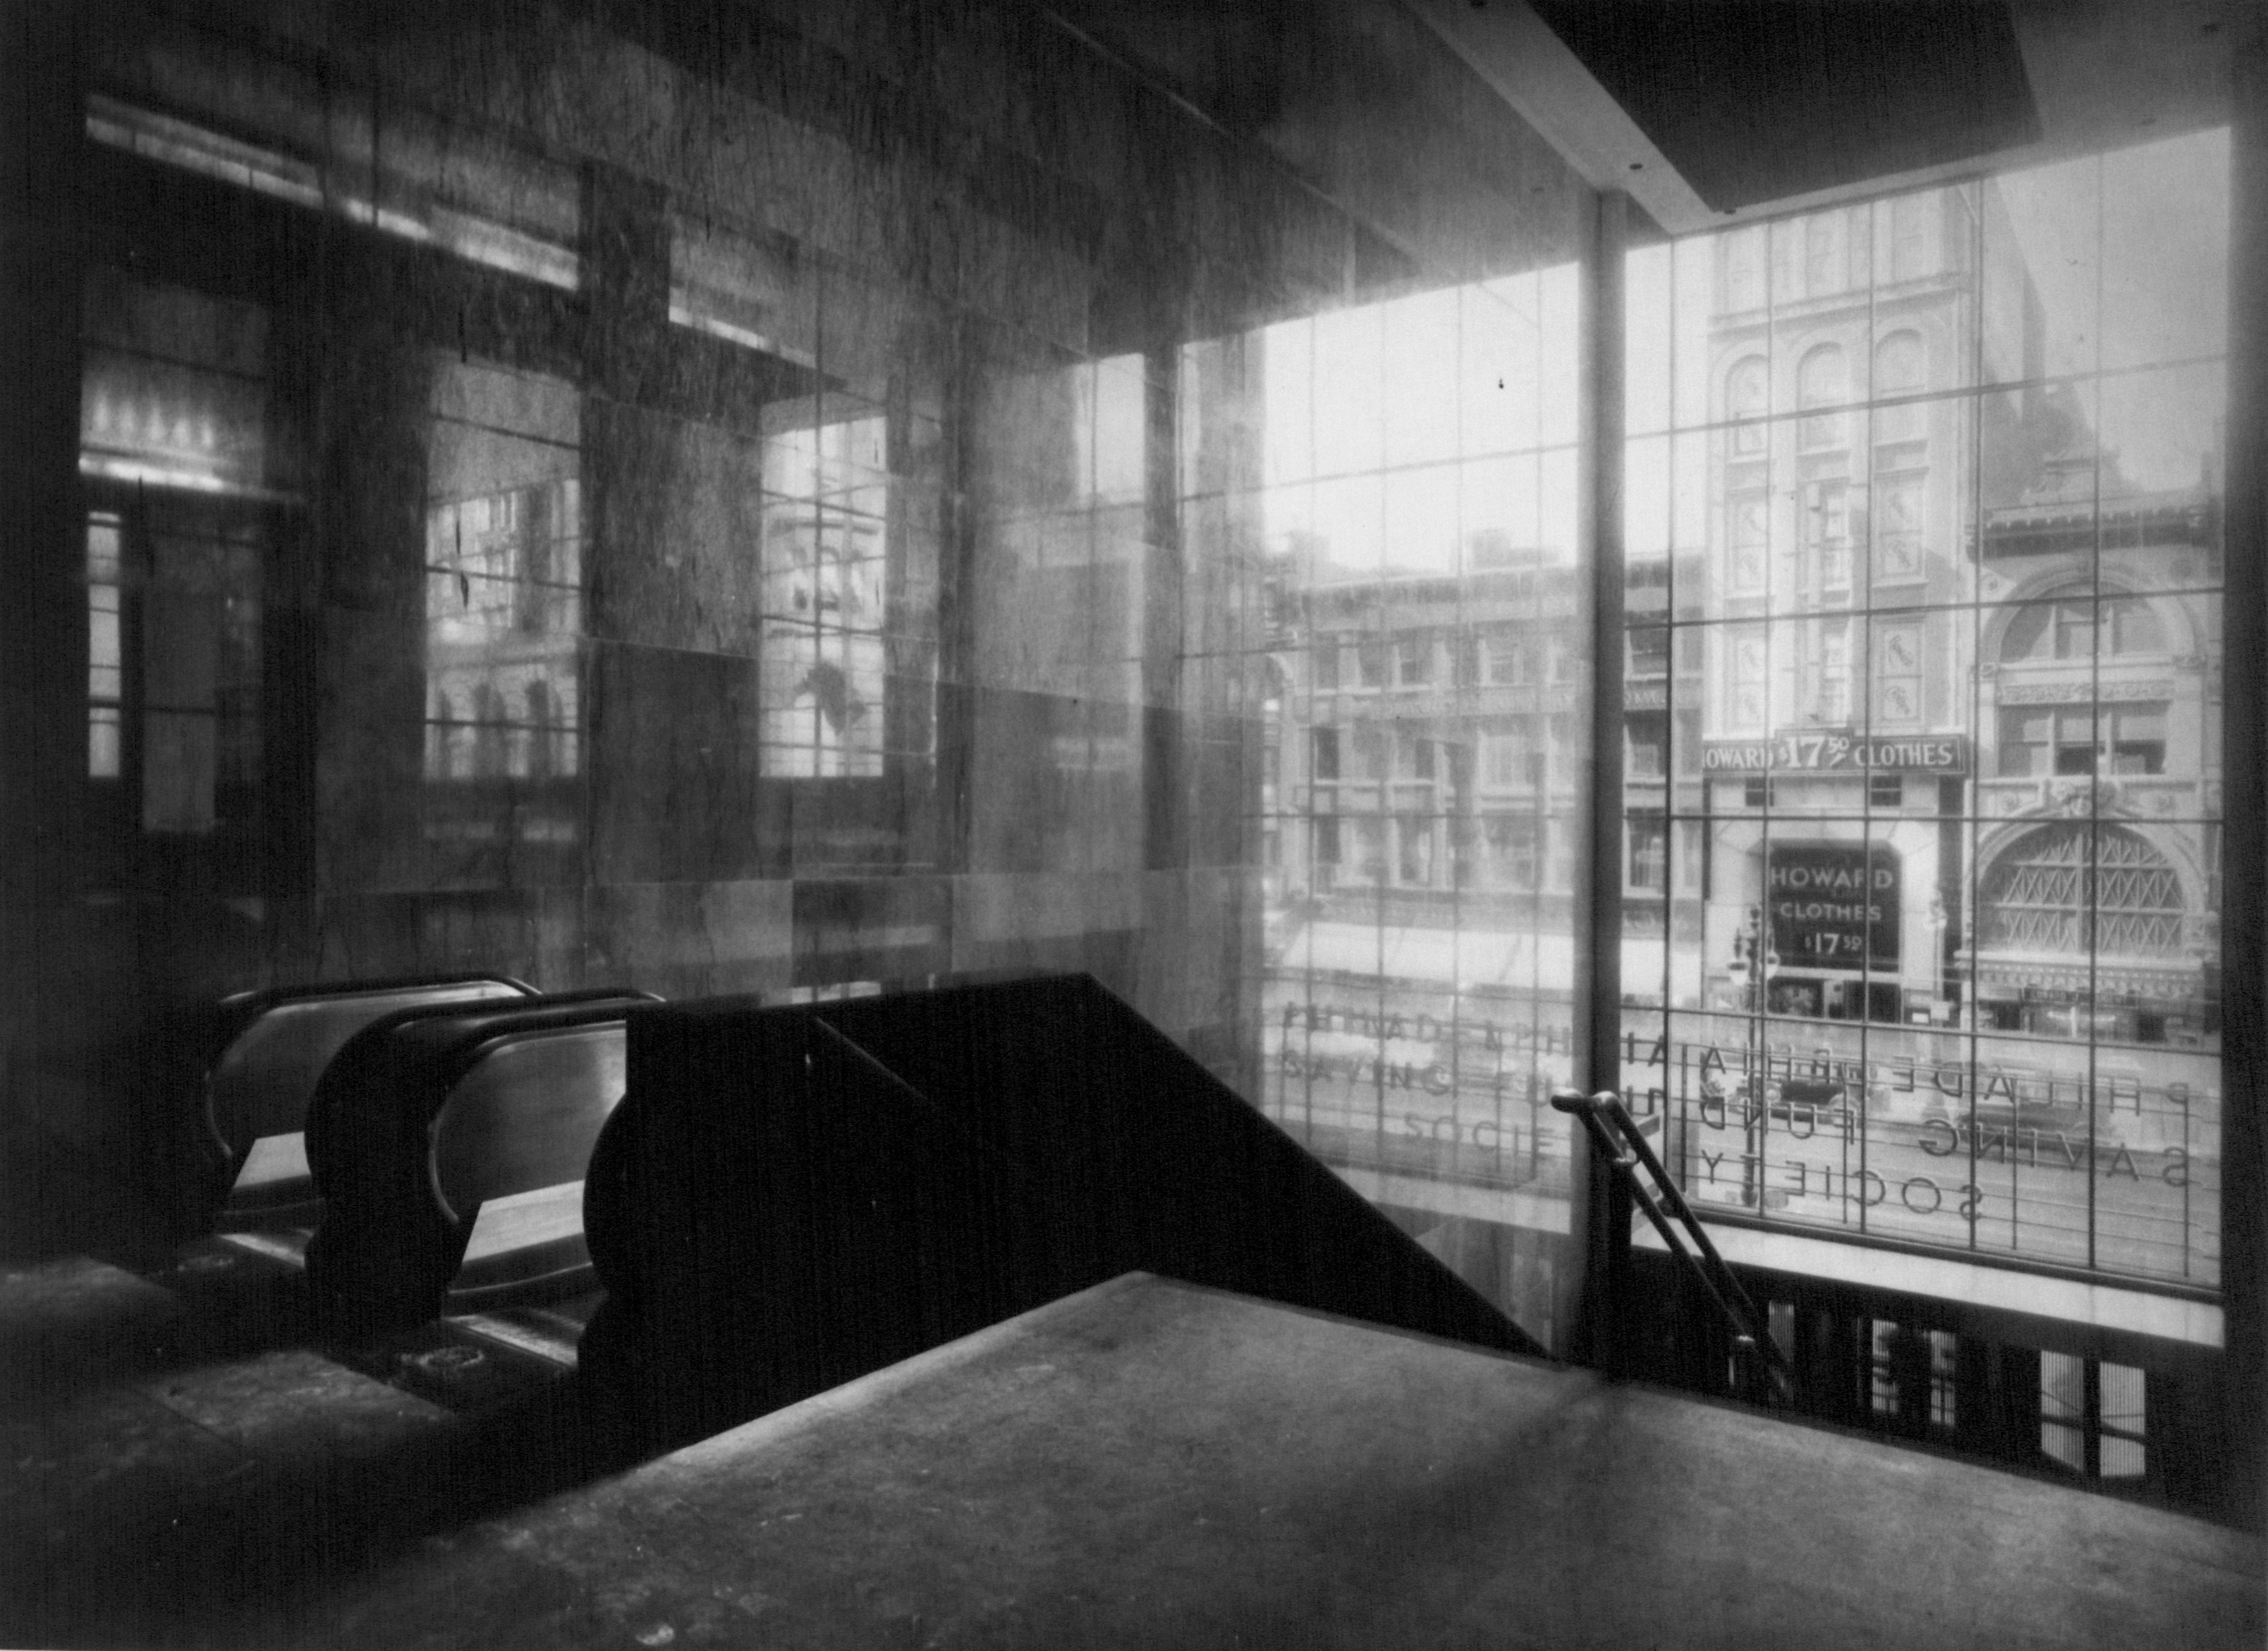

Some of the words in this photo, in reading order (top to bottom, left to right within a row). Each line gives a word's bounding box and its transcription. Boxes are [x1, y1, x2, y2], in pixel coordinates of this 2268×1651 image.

[1855, 742, 1953, 767] CLOTHES
[1771, 867, 1893, 889] HOWARD
[1780, 902, 1882, 921] CLOTHES
